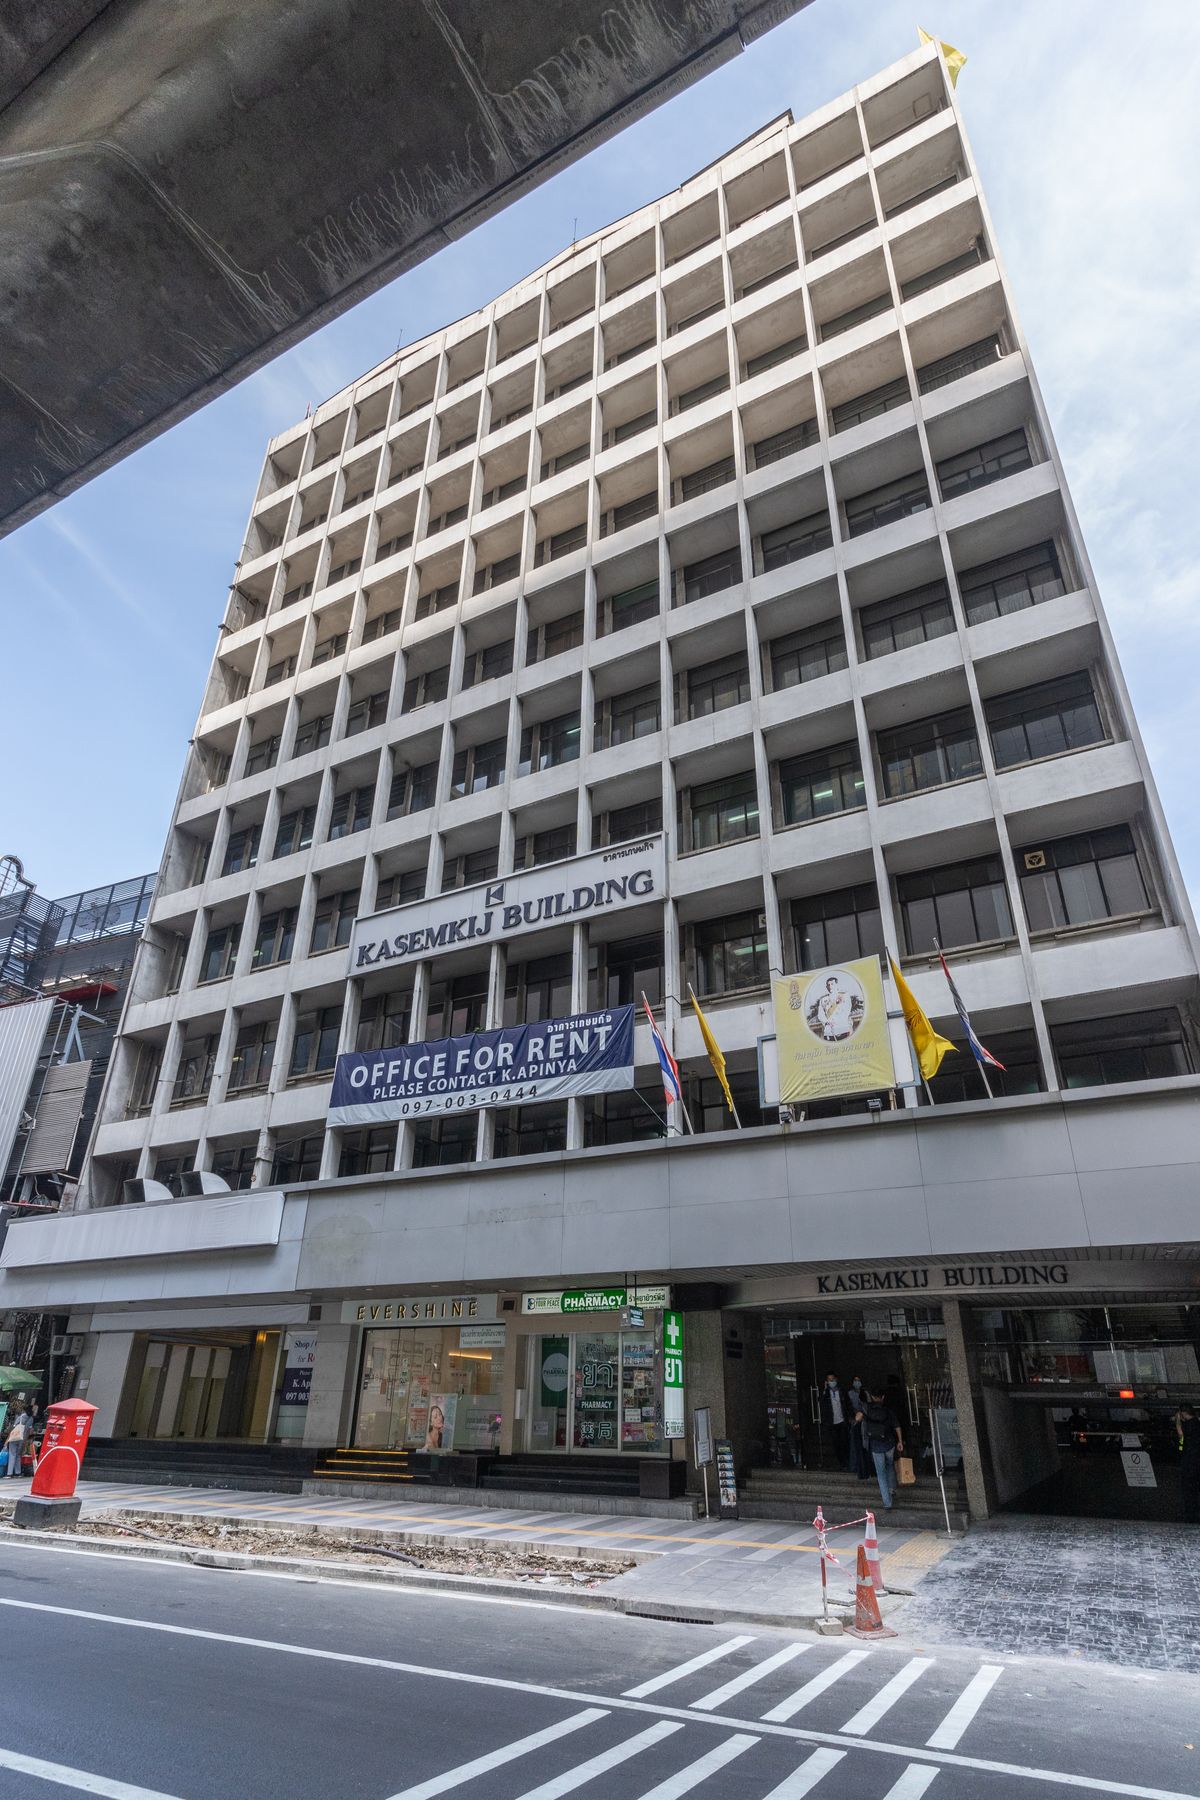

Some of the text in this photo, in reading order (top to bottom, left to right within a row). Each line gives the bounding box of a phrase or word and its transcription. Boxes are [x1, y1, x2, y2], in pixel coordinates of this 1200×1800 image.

[603, 842, 654, 862] อาคารเกษมกิจ
[356, 869, 654, 966] KASEMKIJ BUILDING
[547, 1014, 612, 1033] อาคารเกษมกิจ
[350, 1025, 613, 1088] OFFICE FOR RENT
[373, 1058, 578, 1100] PLEASE CONTACT K.APINYA
[402, 1084, 538, 1115] 097-003-0444
[817, 1264, 1069, 1294] KASEMKIJ BUILDING
[357, 1301, 478, 1320] EVERSHINE
[546, 1298, 560, 1308] PEACE
[564, 1295, 623, 1307] PHARMACY
[294, 1340, 309, 1350] Shop
[664, 1347, 682, 1356] PHARMACY
[582, 1363, 614, 1389] ยา
[665, 1357, 683, 1383] ยา
[285, 1392, 297, 1401] 097
[581, 1400, 612, 1410] PHARMACY
